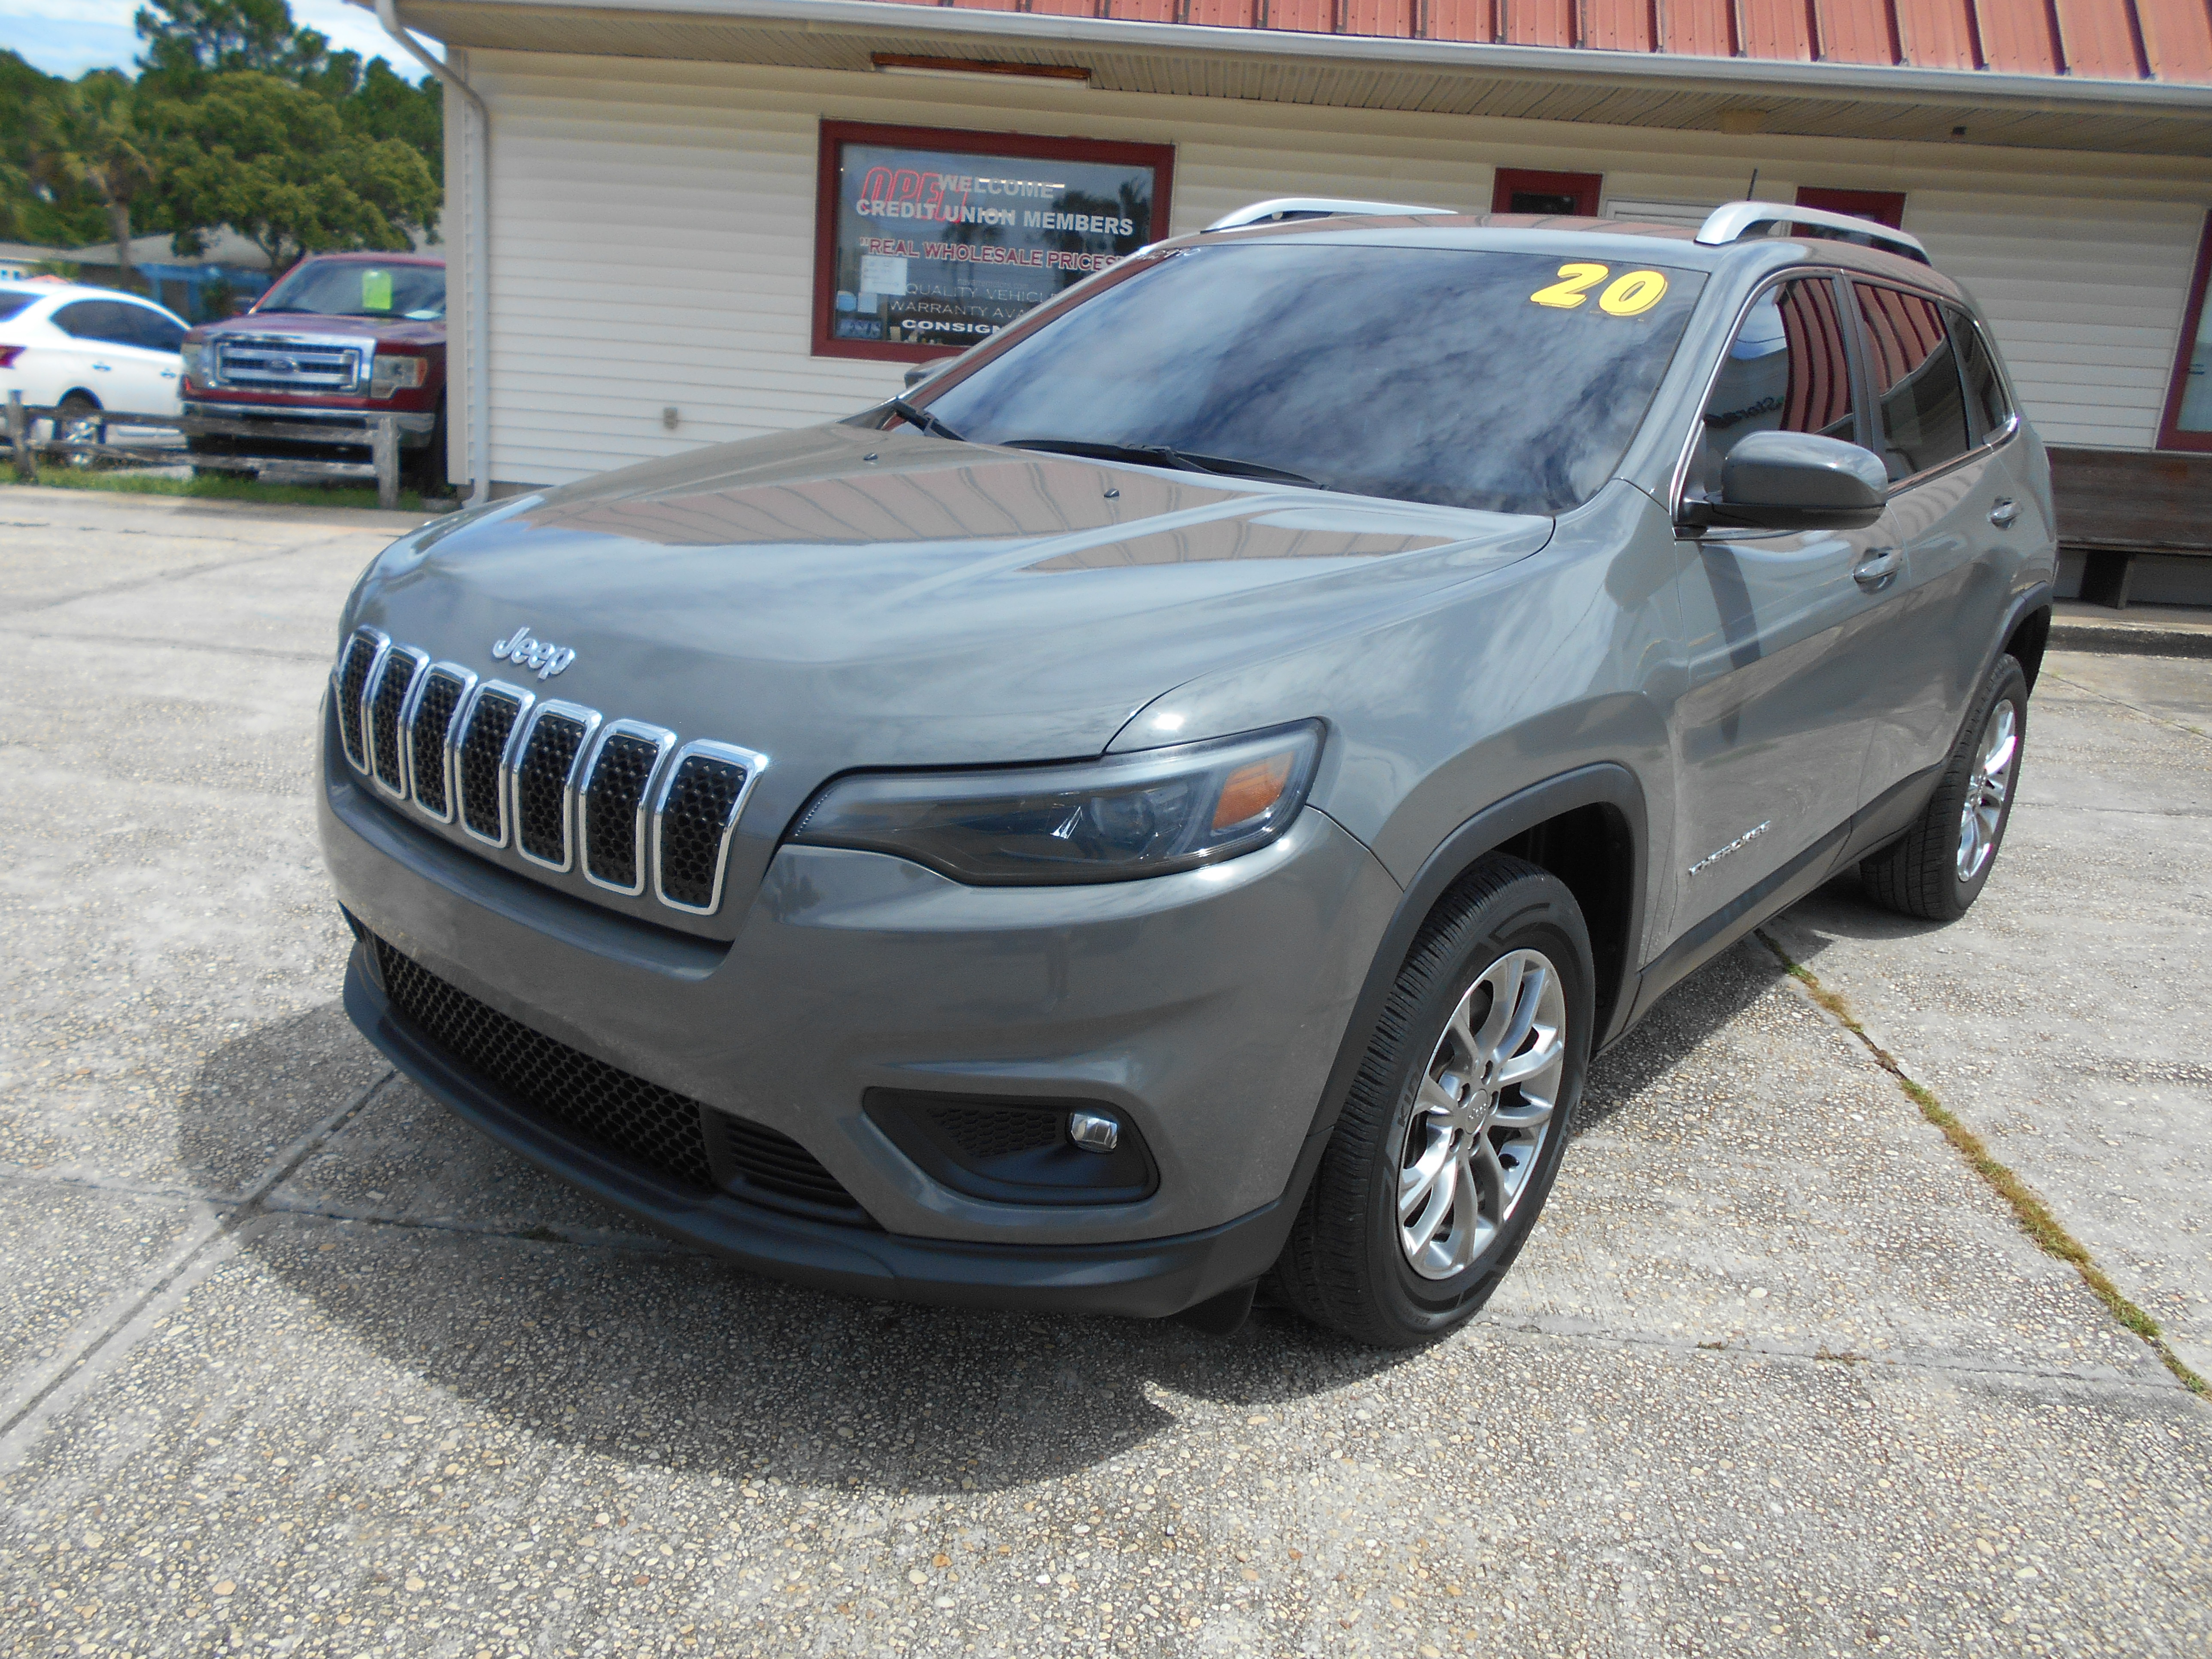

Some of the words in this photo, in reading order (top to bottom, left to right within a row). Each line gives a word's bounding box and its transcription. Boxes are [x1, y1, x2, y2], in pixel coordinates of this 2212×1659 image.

[860, 166, 968, 224] OPEN
[938, 173, 1054, 198] WELCOME
[856, 199, 937, 220] CREDIT
[945, 204, 1016, 226] UNION
[1023, 210, 1133, 236] MEMBERS
[922, 241, 1043, 267] WHOLESALE
[906, 283, 978, 298] QUALITY
[986, 288, 1057, 302] VEHICL
[1530, 263, 1668, 316] 20
[890, 301, 988, 316] WARRANTY
[492, 626, 576, 680] Jeep
